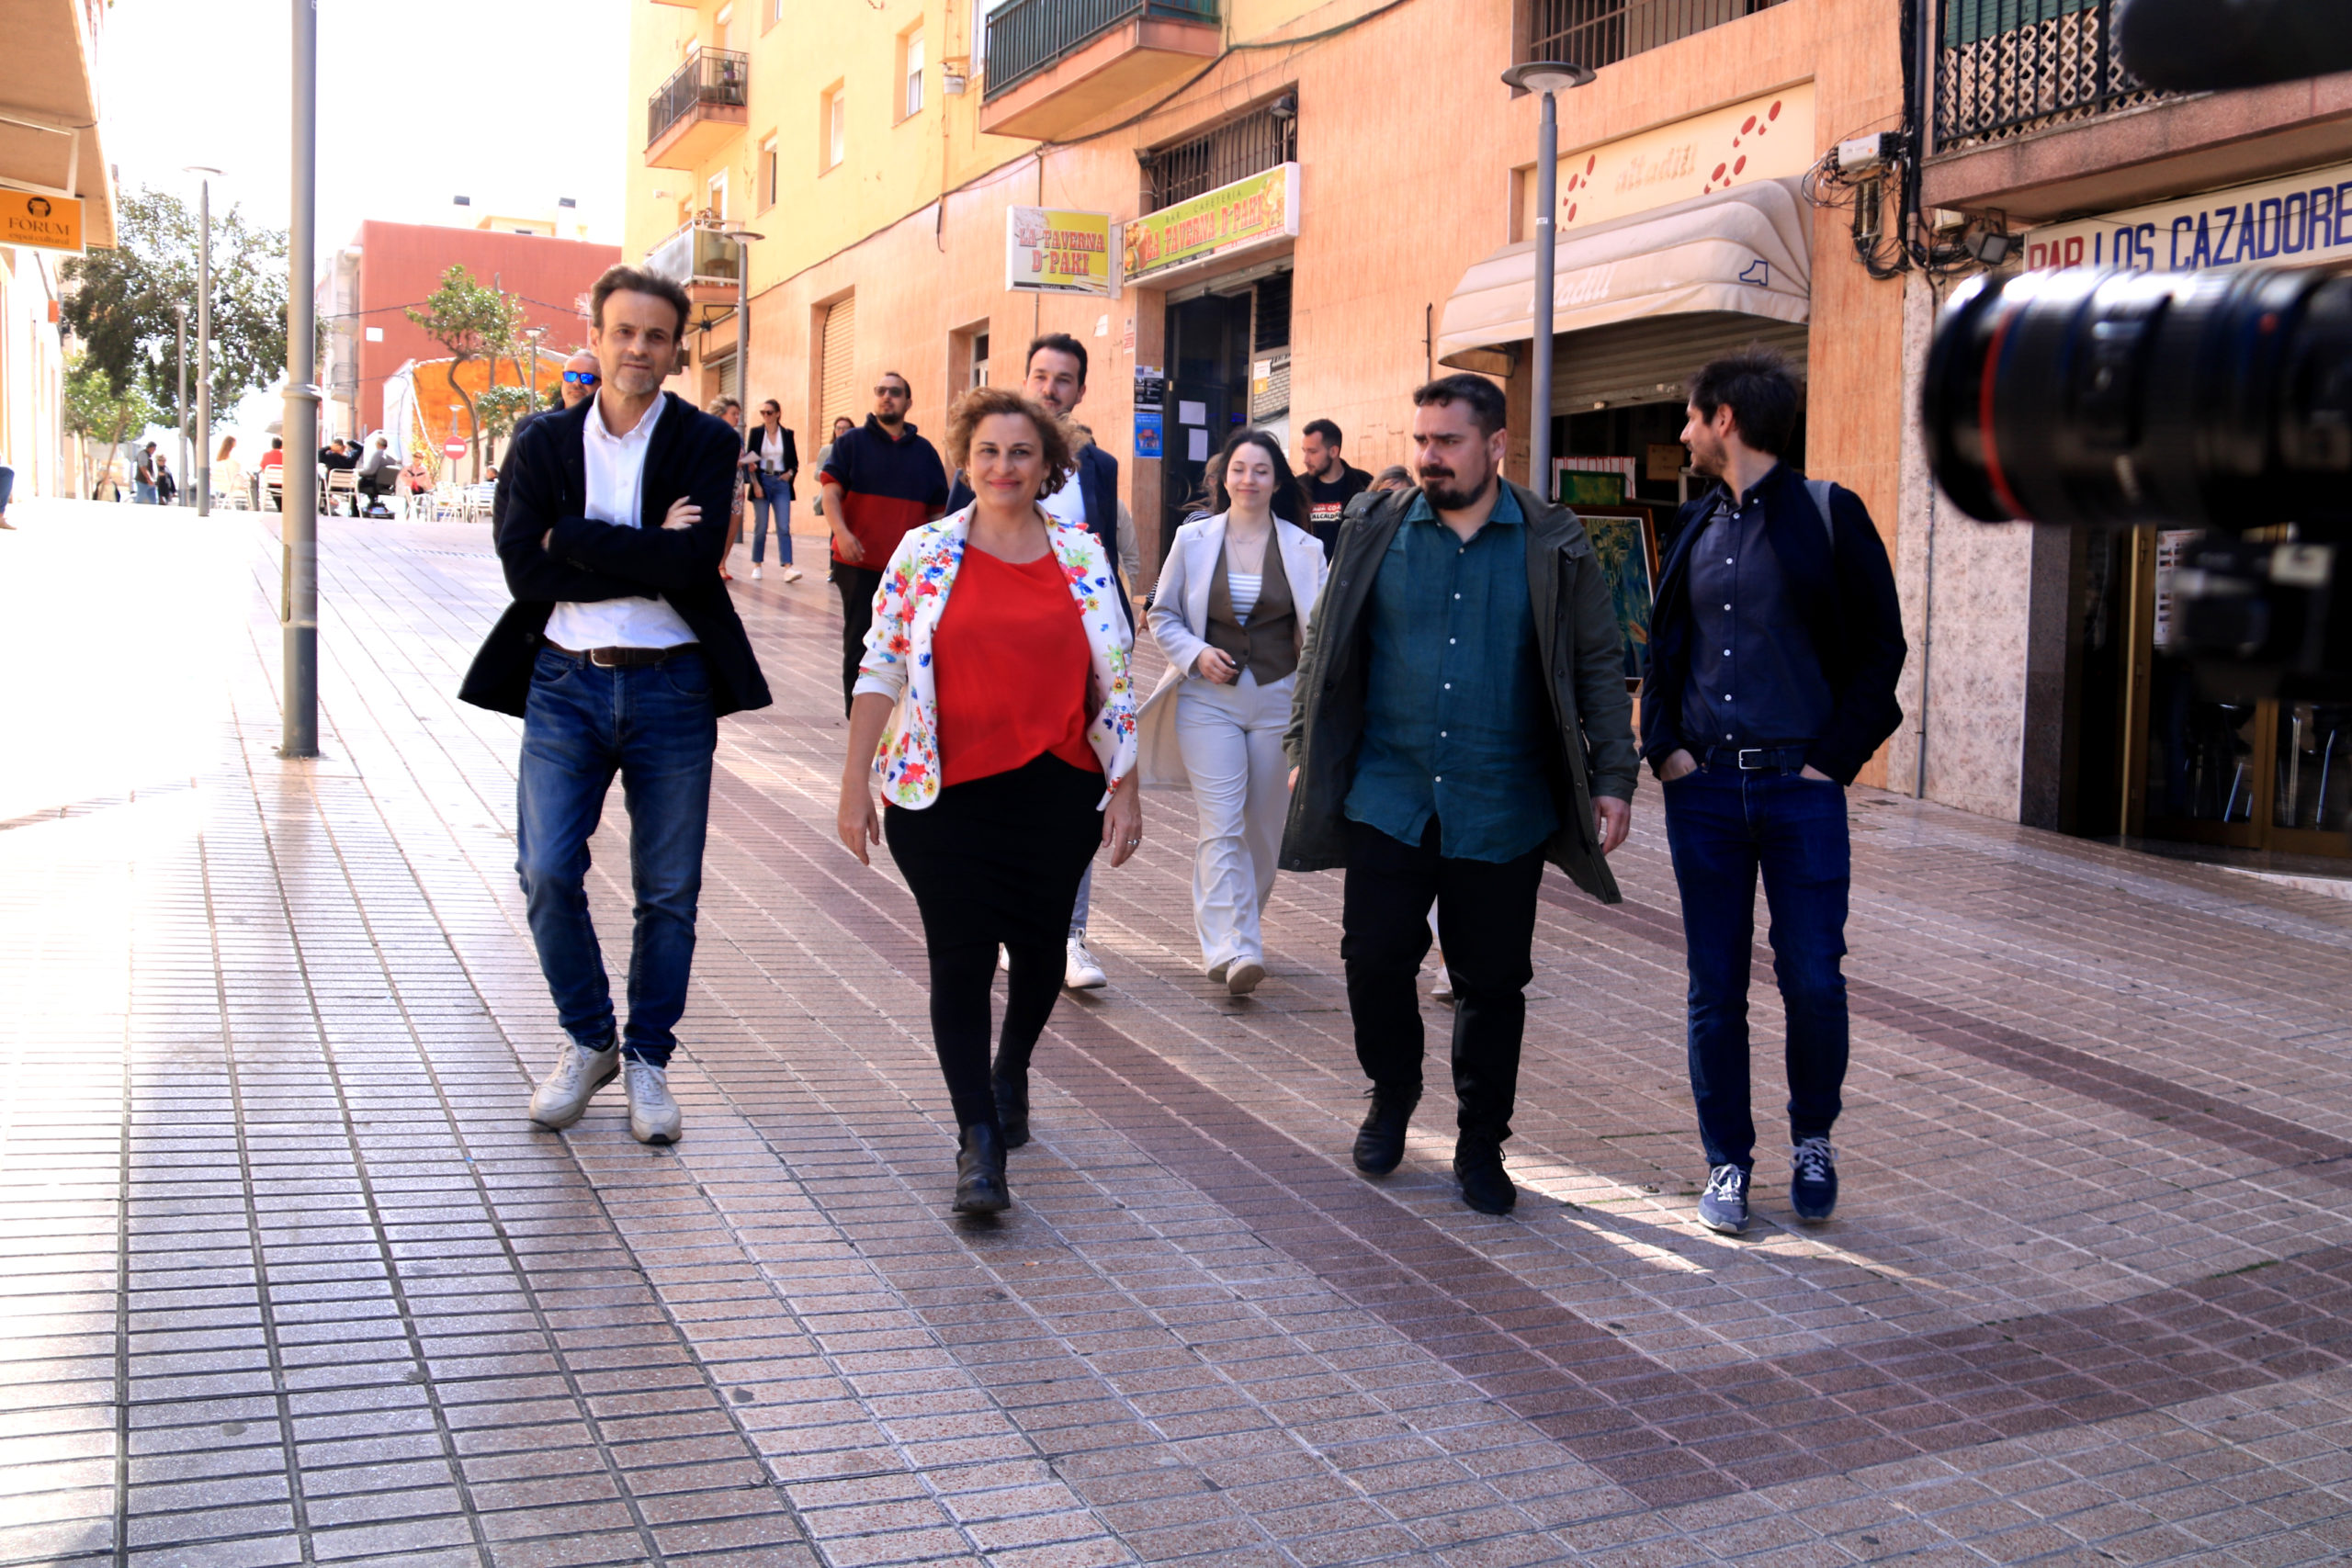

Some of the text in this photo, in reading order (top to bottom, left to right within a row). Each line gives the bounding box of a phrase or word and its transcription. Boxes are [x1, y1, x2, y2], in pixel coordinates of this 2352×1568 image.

[1165, 212, 1181, 223] BAR
[1019, 227, 1105, 253] LA TAVERNA
[1146, 231, 1160, 262] LA
[1164, 209, 1216, 257] TAVERNA
